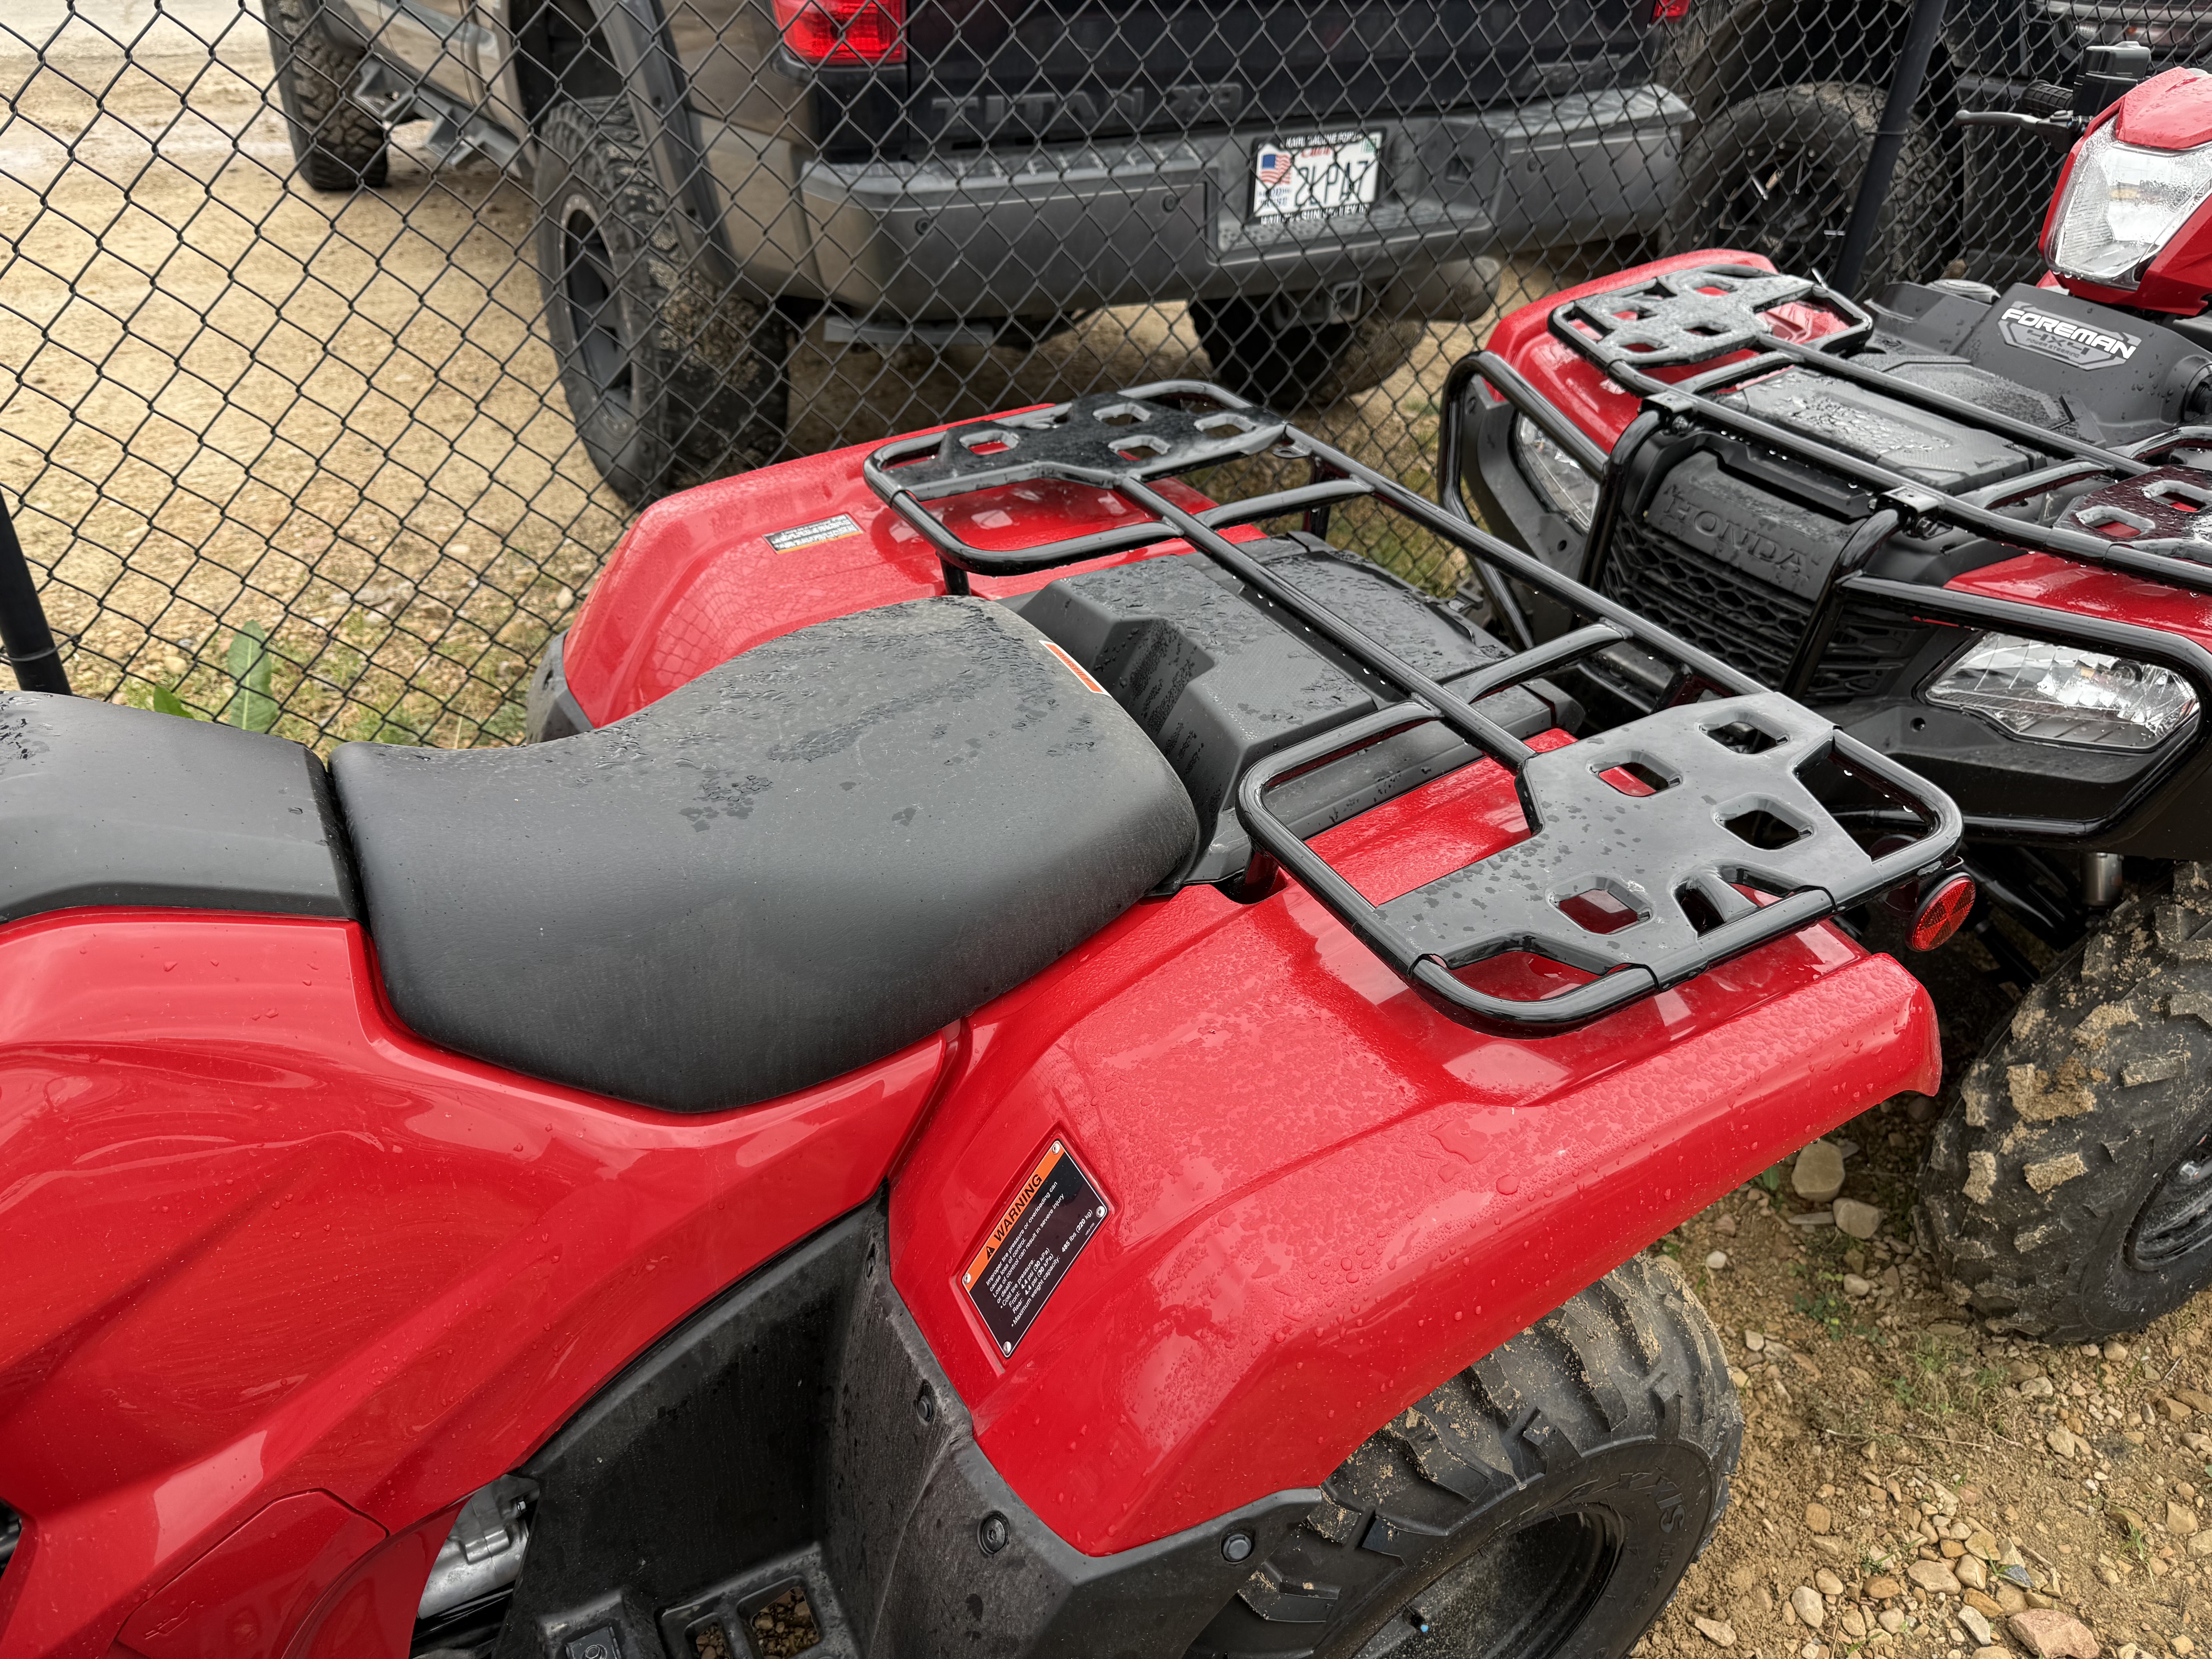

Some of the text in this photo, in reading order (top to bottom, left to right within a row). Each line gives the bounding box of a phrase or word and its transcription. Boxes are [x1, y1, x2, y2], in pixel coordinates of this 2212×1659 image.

[2001, 308, 2136, 359] FOREMAN
[2026, 338, 2080, 358] POWER STEERING
[1664, 496, 1810, 581] HONDA
[985, 1261, 1002, 1286] Improper
[1008, 1229, 1024, 1254] pressure
[1028, 1192, 1050, 1223] overloading
[1049, 1181, 1058, 1192] can
[993, 1174, 1042, 1242] WARNING
[989, 1237, 1026, 1292] cause loss of control.
[992, 1283, 1003, 1298] Loss
[1001, 1276, 1007, 1285] of
[1006, 1257, 1019, 1278] control
[1018, 1248, 1026, 1260] can
[1025, 1232, 1037, 1249] result
[1039, 1209, 1053, 1228] severe
[1052, 1193, 1064, 1209] injury
[1012, 1297, 1032, 1325] Maximum
[1030, 1279, 1044, 1298] weight
[1043, 1255, 1060, 1280] capacity:
[1061, 1240, 1070, 1252] 485
[1068, 1232, 1077, 1242] lbs
[1075, 1218, 1085, 1233] (220
[1084, 1209, 1093, 1220] kg)
[996, 1280, 1013, 1304] or death.
[1002, 1291, 1012, 1306] Cold
[1017, 1258, 1035, 1285] pressure:
[1008, 1290, 1021, 1308] Front:
[1039, 1247, 1050, 1262] kPa)
[1012, 1297, 1024, 1314] Rear:
[1036, 1266, 1044, 1278] (30
[1043, 1253, 1054, 1267] kPa)
